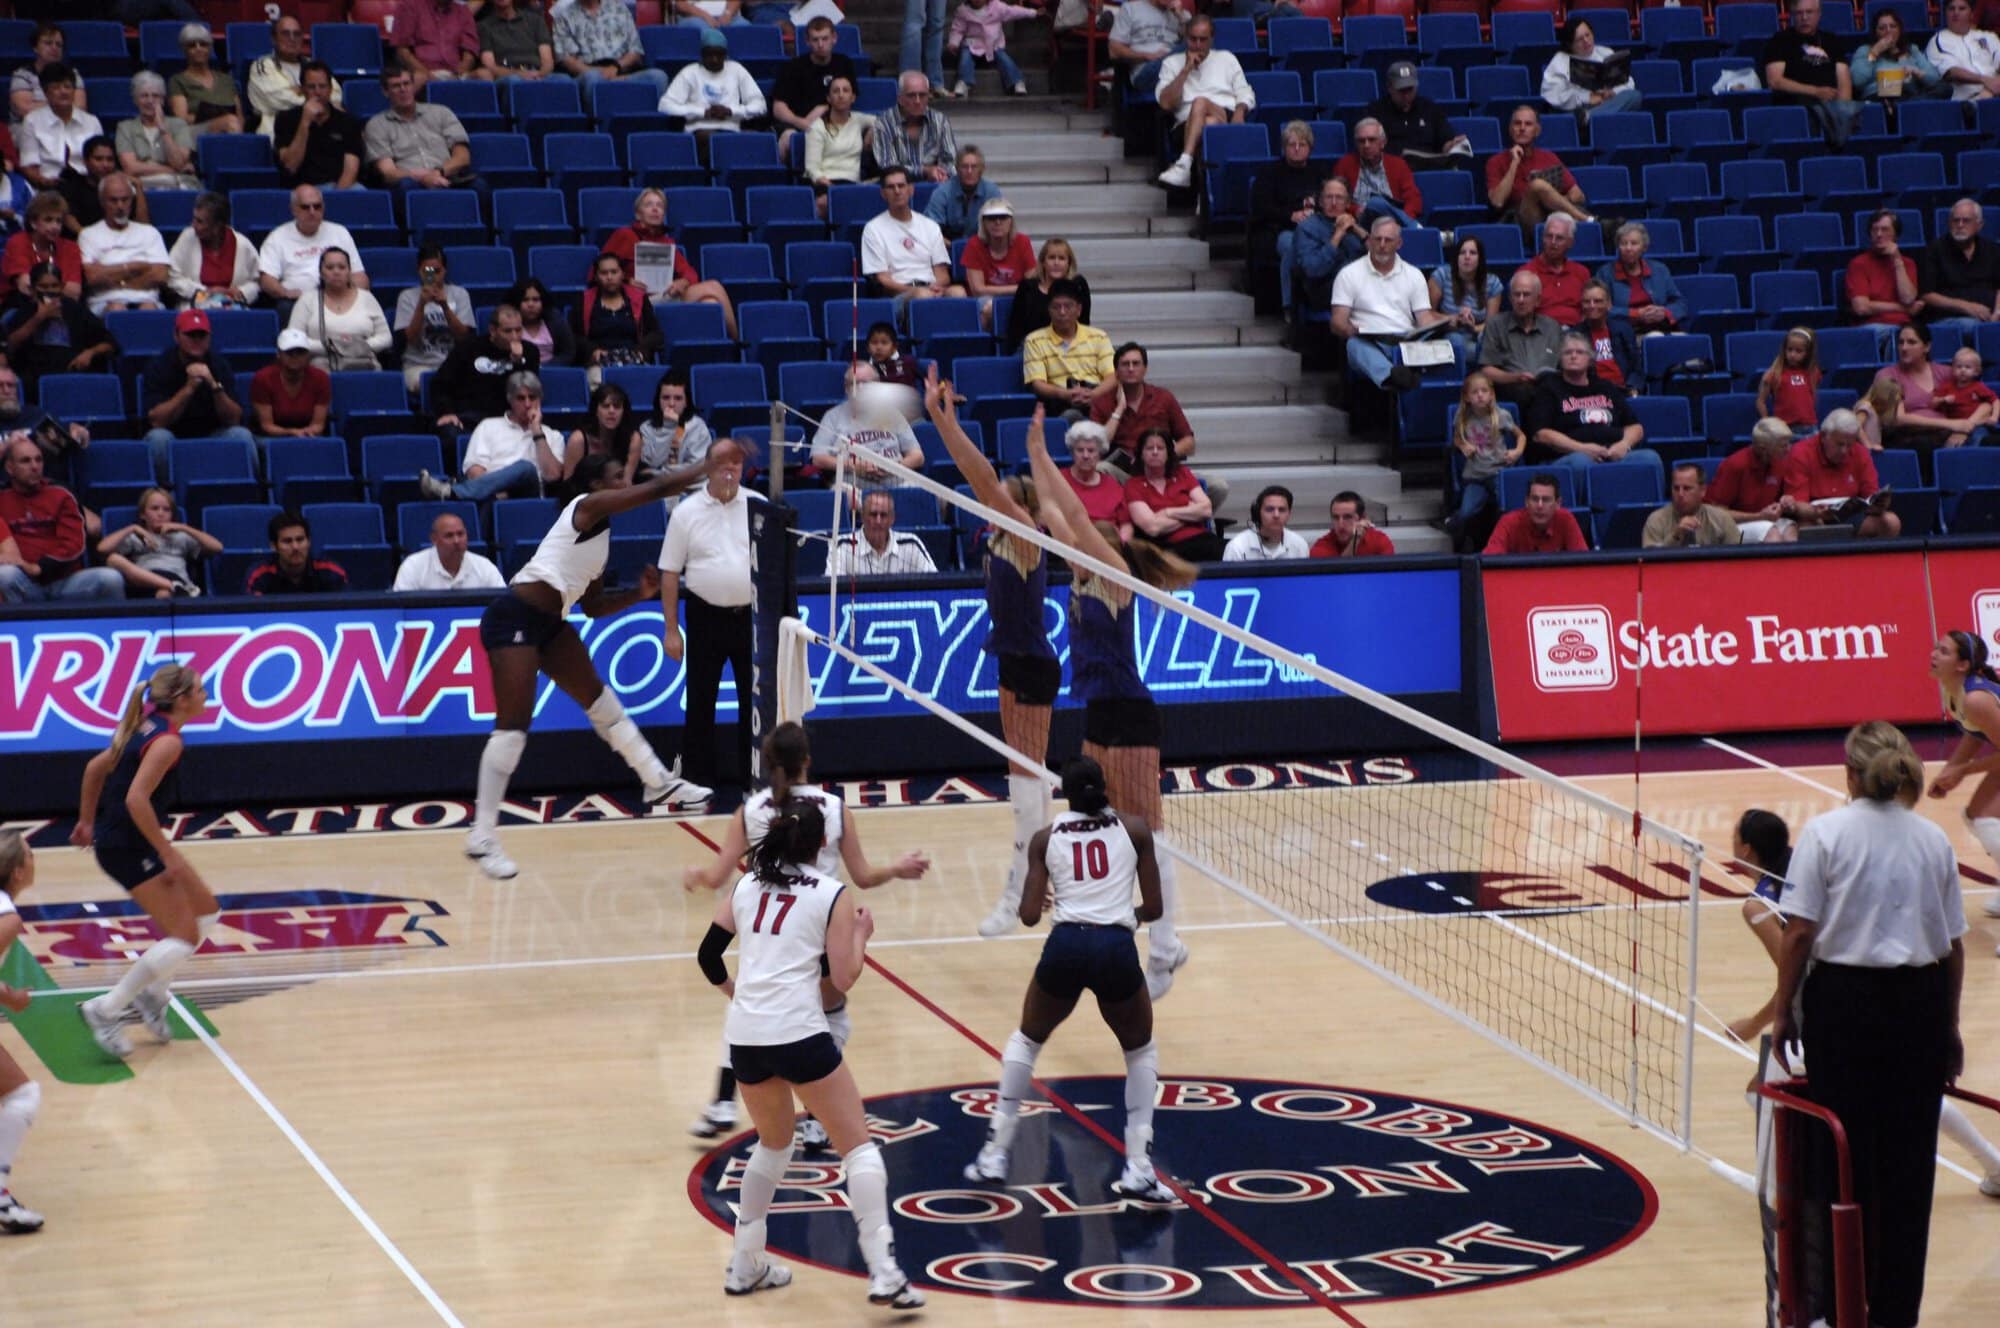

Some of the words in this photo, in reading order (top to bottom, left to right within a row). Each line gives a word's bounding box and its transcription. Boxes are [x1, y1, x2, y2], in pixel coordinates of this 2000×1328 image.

[532, 587, 1273, 718] OEYLL
[749, 541, 761, 795] ARIZON
[1619, 620, 1738, 670] State
[822, 757, 1418, 808] HAIONS
[1072, 838, 1109, 881] 10
[753, 892, 797, 935] 17
[716, 1112, 940, 1213] LUE
[1155, 1081, 1604, 1176] BOBBI
[926, 1220, 1585, 1301] COURT
